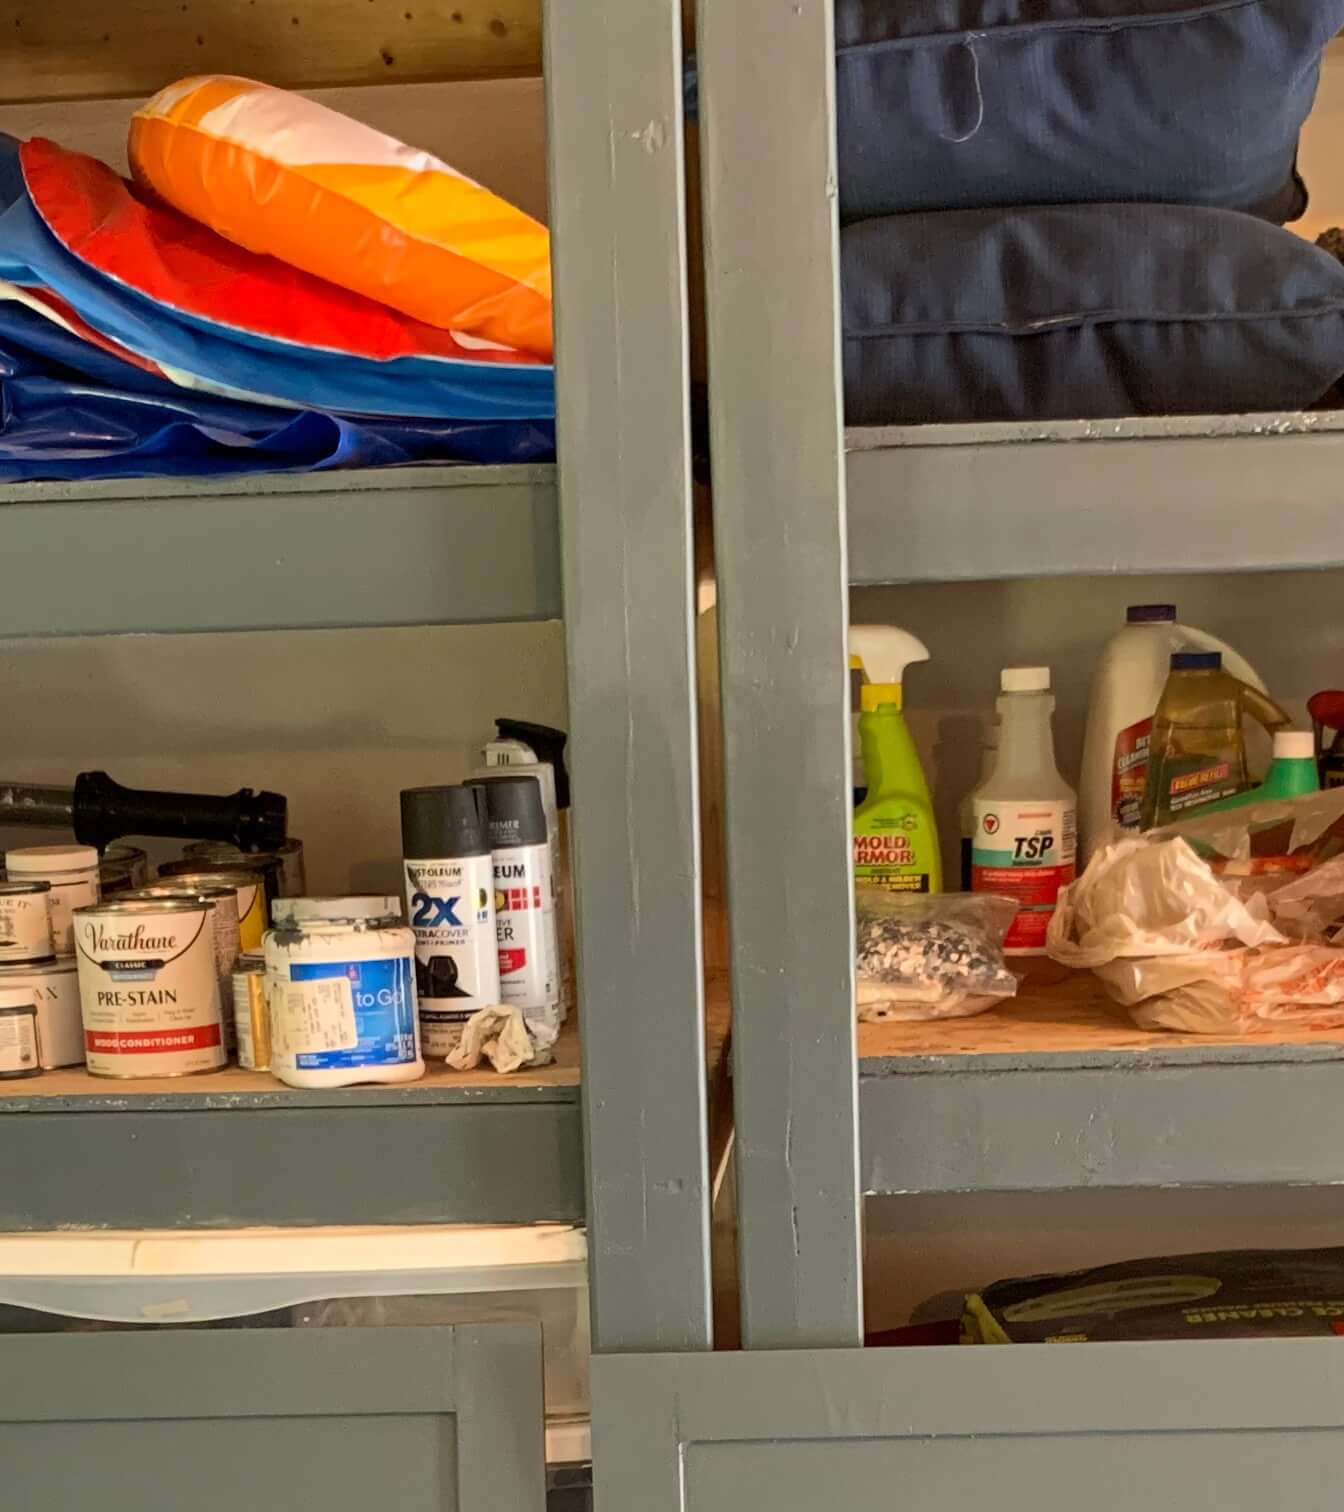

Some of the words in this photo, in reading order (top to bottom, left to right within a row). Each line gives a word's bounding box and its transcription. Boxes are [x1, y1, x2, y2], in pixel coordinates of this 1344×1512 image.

[853, 835, 908, 850] MOLD
[1013, 836, 1055, 859] TSP
[855, 850, 915, 865] RMOR
[411, 892, 464, 928] 2X
[84, 922, 178, 954] Varathane
[96, 989, 178, 1007] PRE-STAIN
[356, 992, 375, 1007] to
[377, 988, 404, 1006] Go
